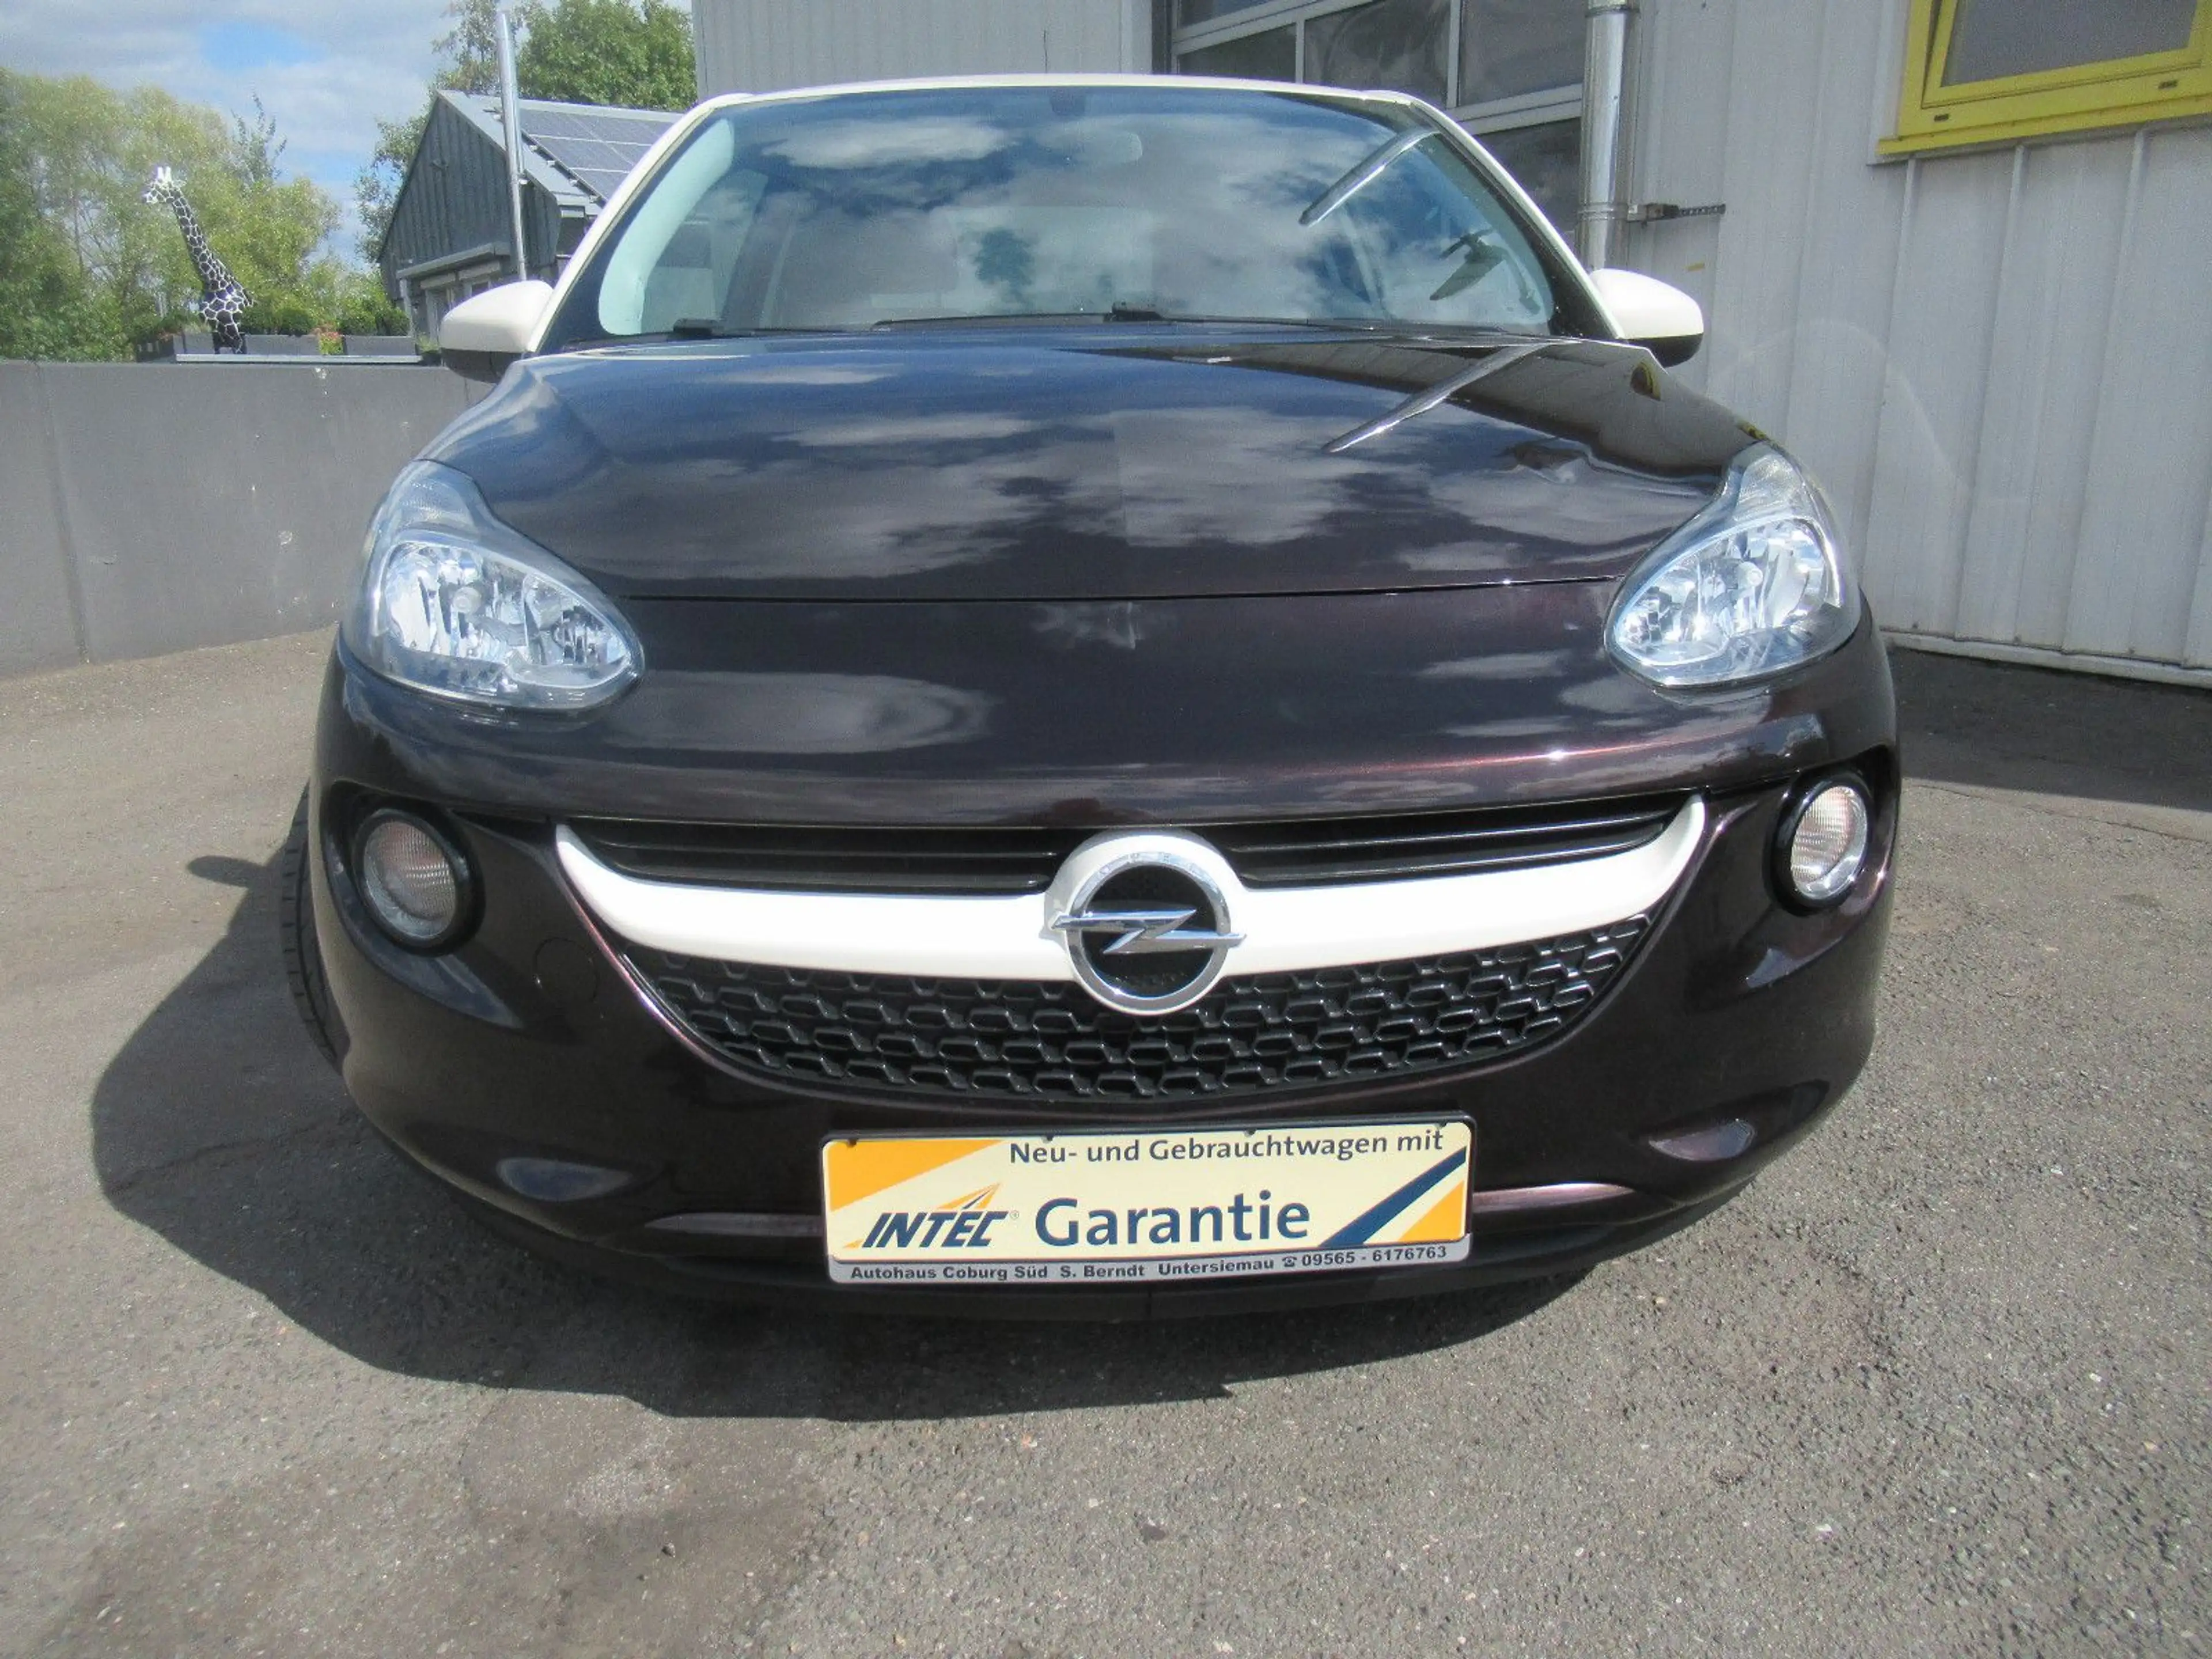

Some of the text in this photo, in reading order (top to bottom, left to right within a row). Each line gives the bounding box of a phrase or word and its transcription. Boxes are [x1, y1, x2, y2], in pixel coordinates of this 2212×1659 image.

[1010, 1130, 1444, 1163] Neu- und Gebrauchtwagen mit
[1035, 1190, 1310, 1247] Garantie
[851, 1266, 937, 1279] Autohaus
[942, 1266, 1007, 1281] Coburg
[1014, 1264, 1048, 1279] Süd
[1060, 1266, 1077, 1278] S.
[1083, 1264, 1145, 1278] Berndt
[1158, 1257, 1274, 1275] Untersiemau
[1302, 1251, 1355, 1266] 09565
[1373, 1245, 1446, 1263] 6176763
